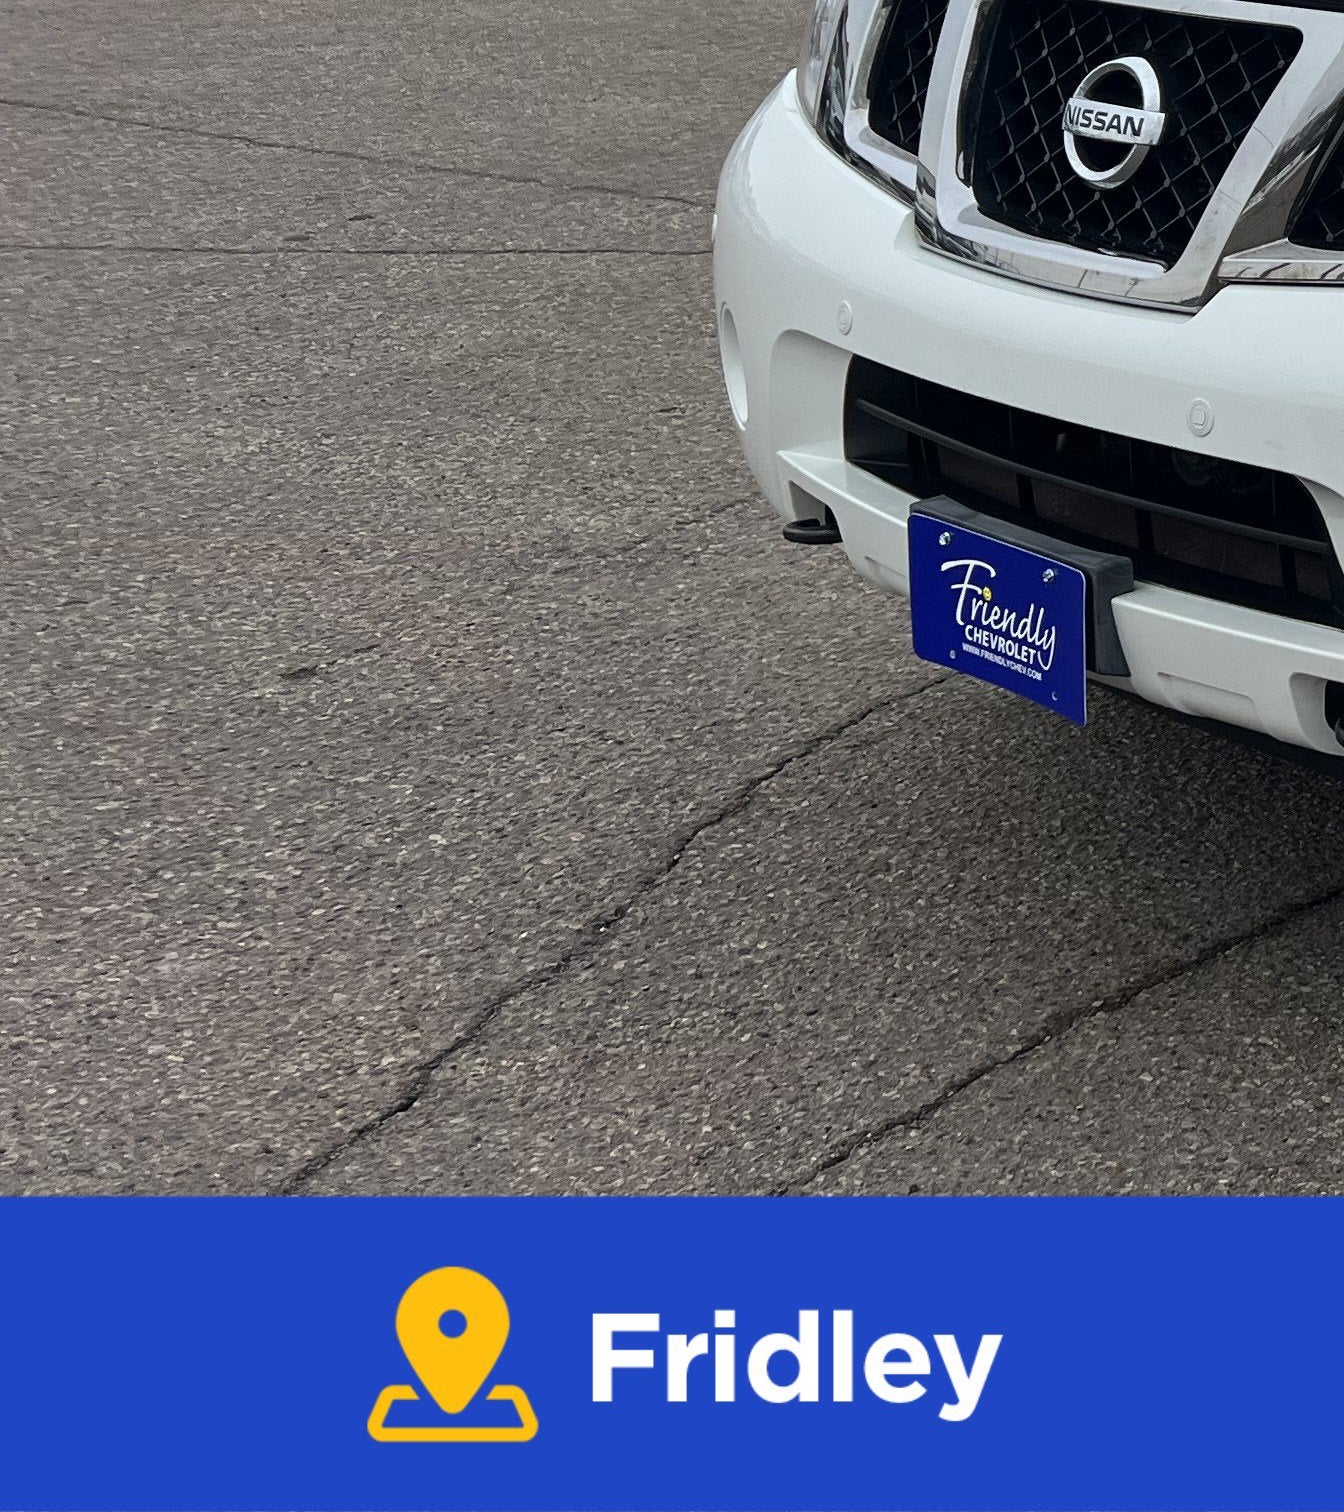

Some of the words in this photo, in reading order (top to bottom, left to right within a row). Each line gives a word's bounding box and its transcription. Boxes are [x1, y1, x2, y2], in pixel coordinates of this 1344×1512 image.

[1064, 104, 1145, 137] NISSAN
[940, 559, 1056, 671] Friendly
[962, 642, 1043, 682] WWW.FRIENDLYCHEV.COM
[964, 625, 1037, 665] CHEVROLET
